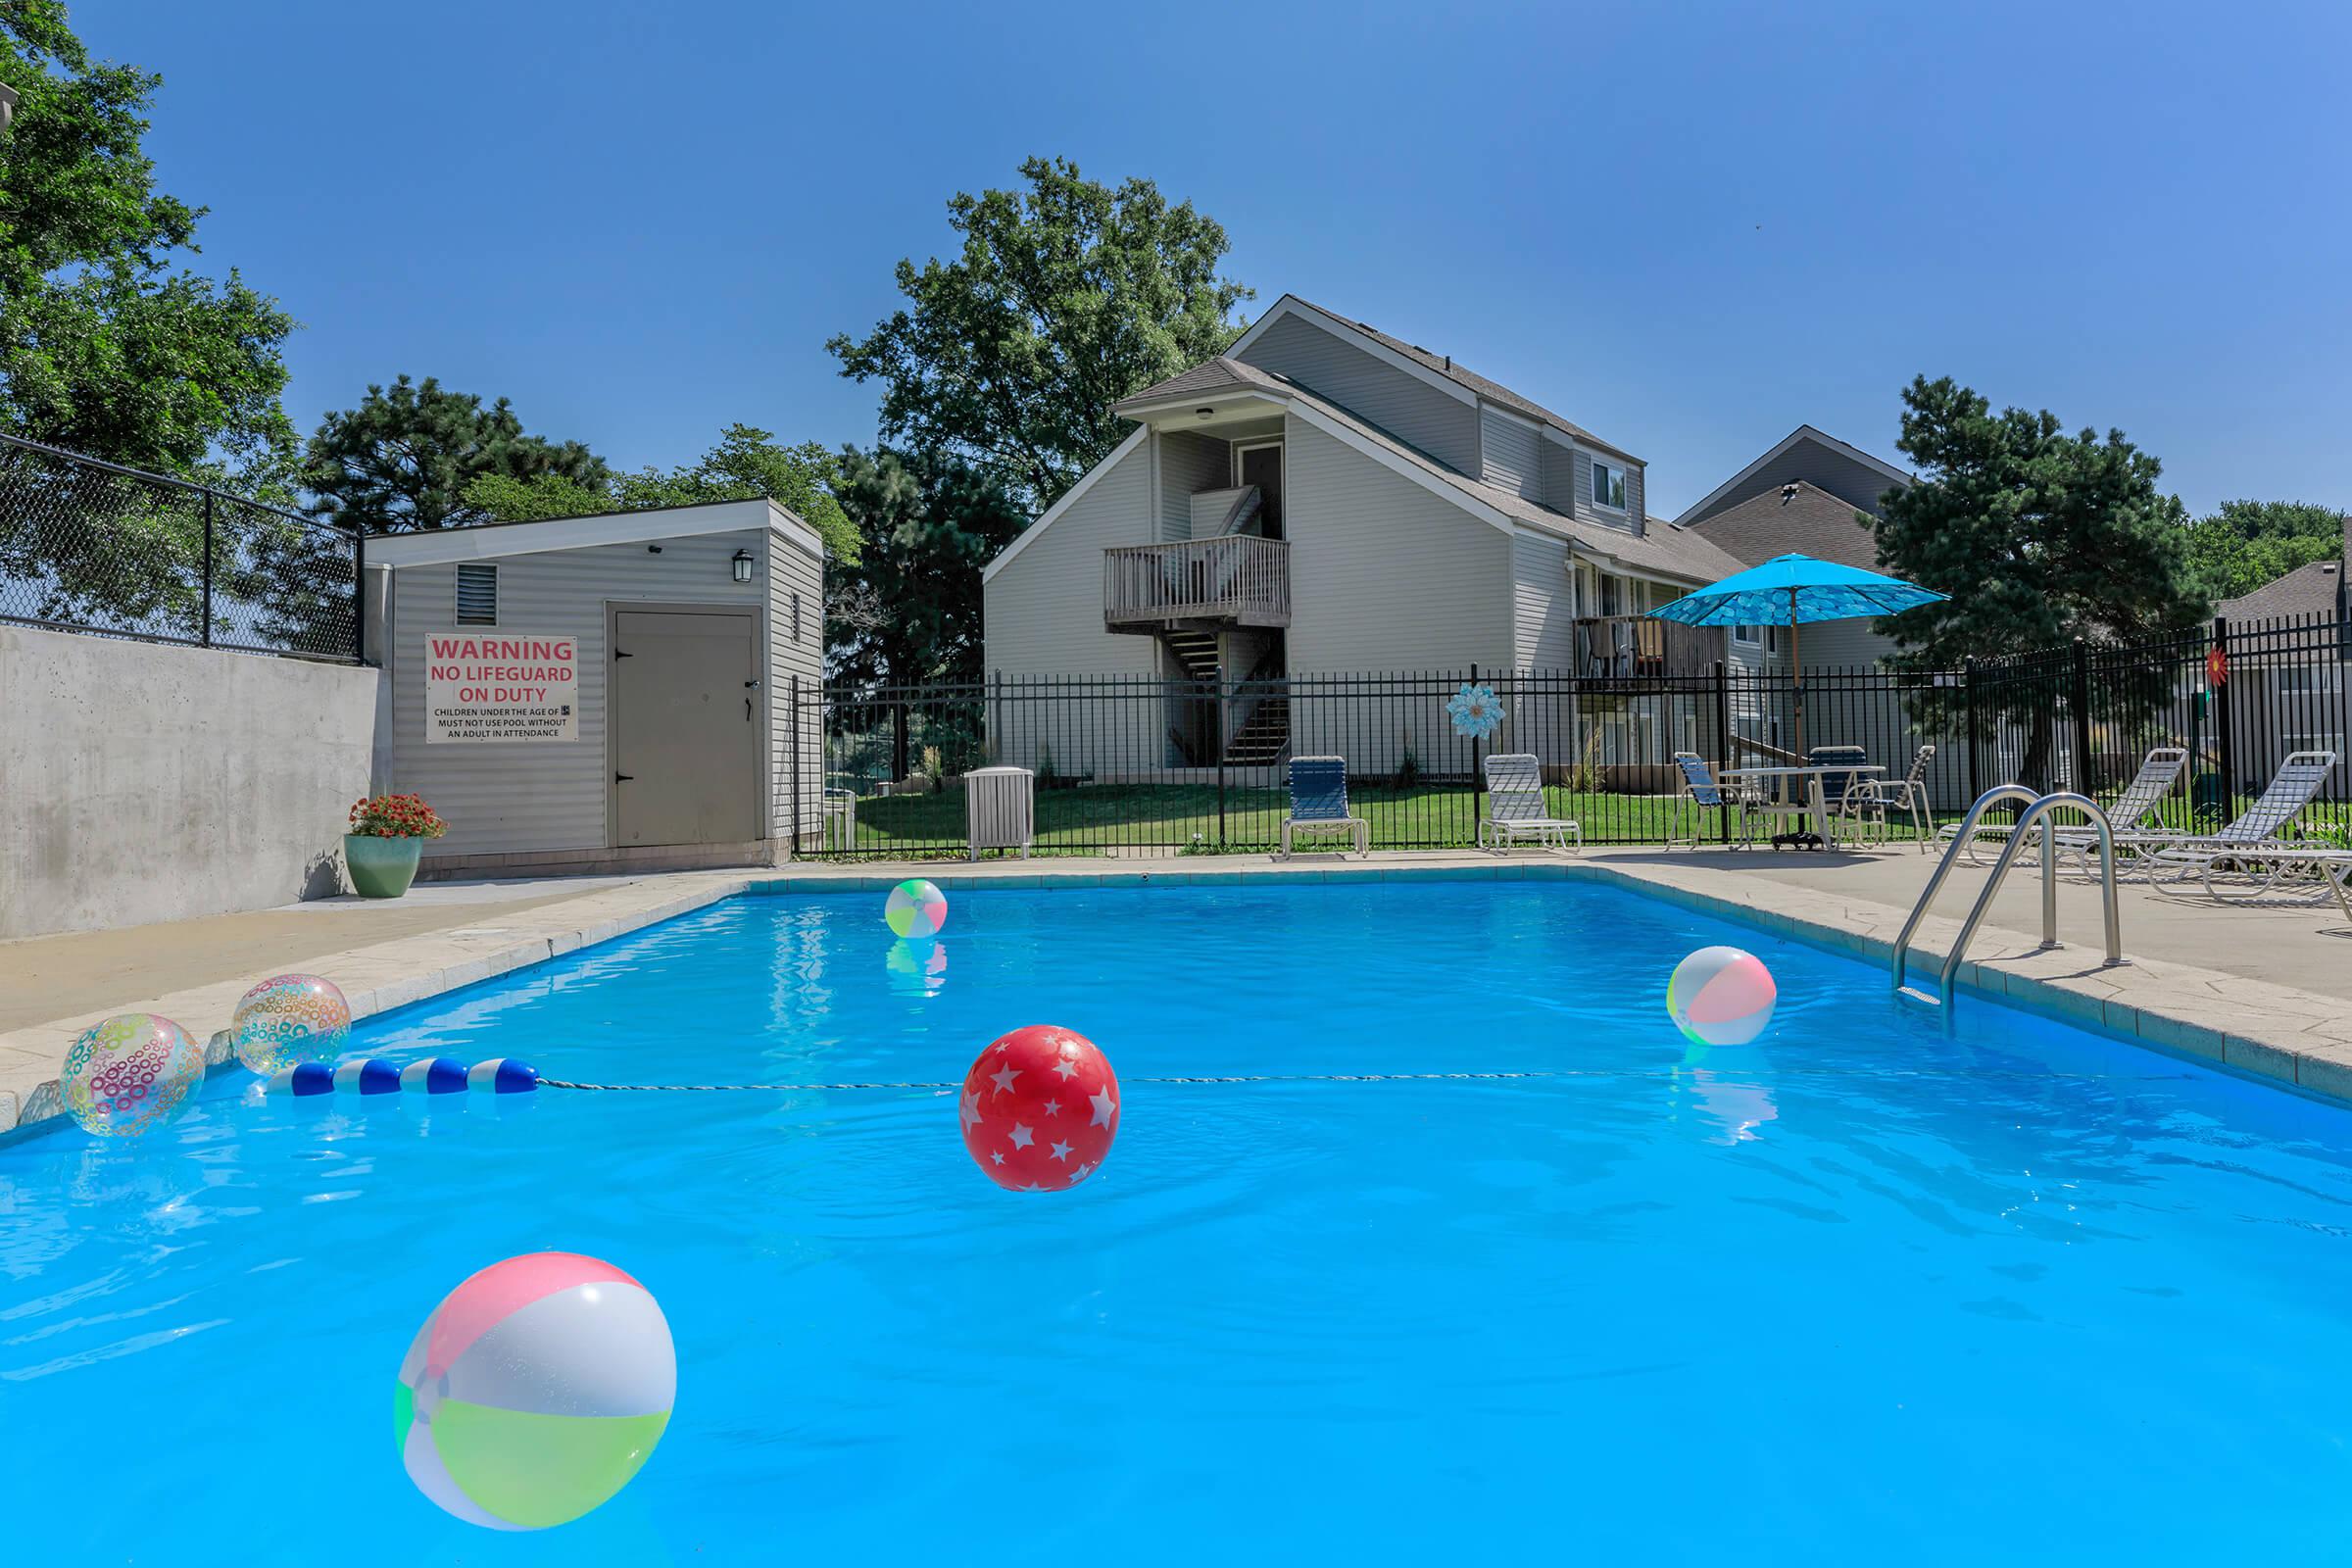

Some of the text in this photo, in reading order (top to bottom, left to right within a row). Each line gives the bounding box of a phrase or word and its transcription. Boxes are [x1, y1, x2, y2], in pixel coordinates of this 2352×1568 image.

[432, 640, 572, 661] WARNING
[431, 666, 572, 681] NO LIFEGUARD
[459, 688, 547, 702] ON DUTY
